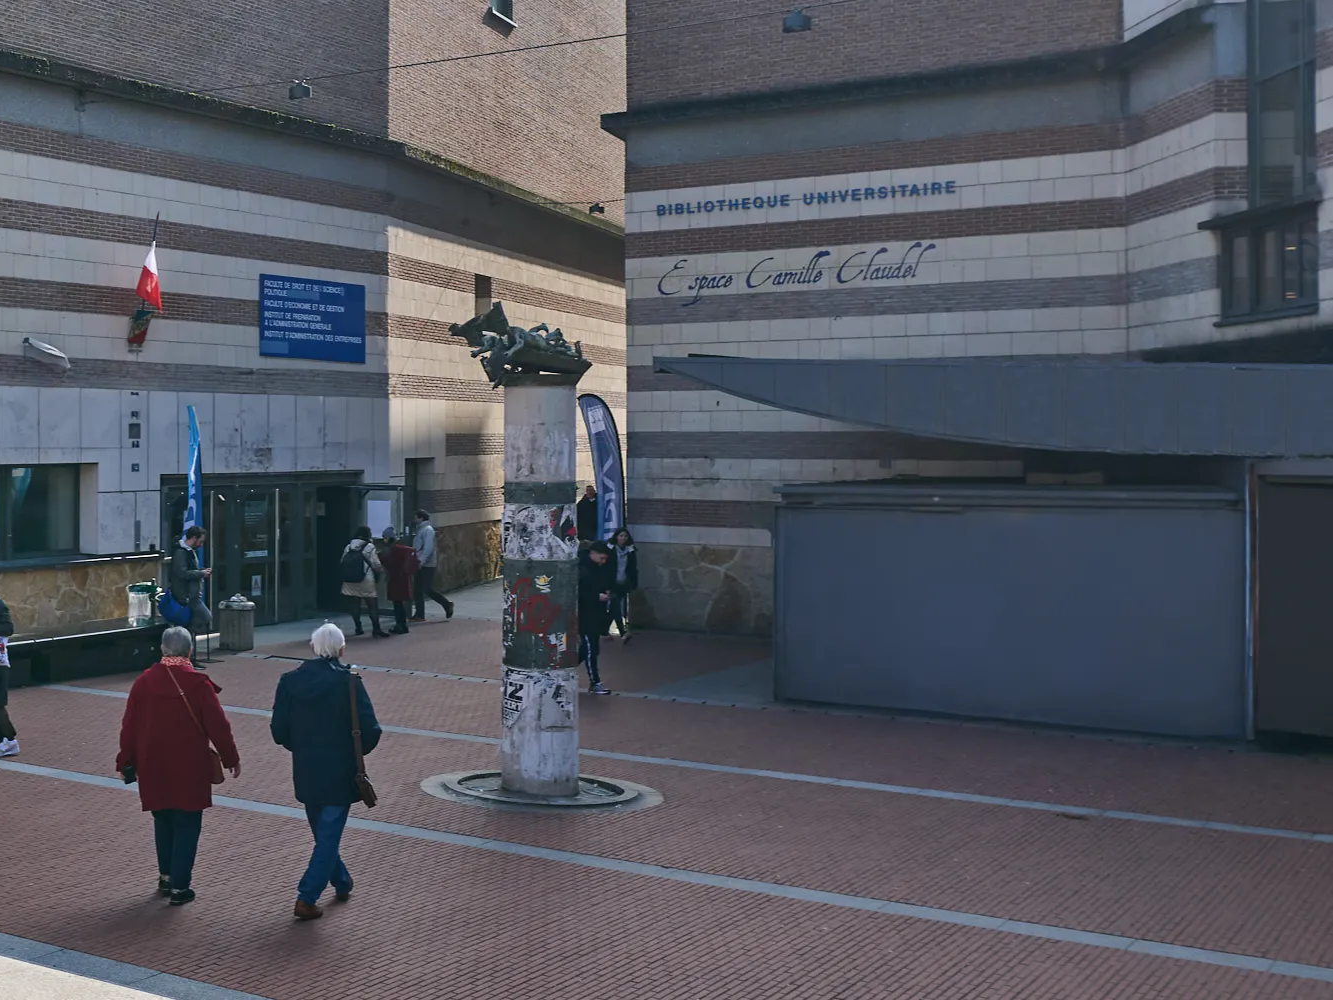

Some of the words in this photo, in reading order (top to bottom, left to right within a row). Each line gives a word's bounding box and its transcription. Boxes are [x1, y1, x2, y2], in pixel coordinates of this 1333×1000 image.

[656, 193, 791, 217] BIBLIOTHEQUE
[802, 180, 957, 206] UNIVERSITAIRE
[657, 258, 734, 307] Espace
[745, 250, 831, 289] Camille
[836, 241, 937, 284] Claudel
[284, 281, 290, 289] DE
[292, 282, 305, 290] DROIT
[264, 288, 288, 297] POLITIQUE
[326, 304, 344, 312] GESTION
[264, 311, 284, 319] INSTITUT
[264, 331, 284, 339] INSTITUT
[285, 332, 324, 341] D'ADMINISTRATION
[325, 334, 333, 342] DES
[335, 335, 362, 344] ENTREPRISES
